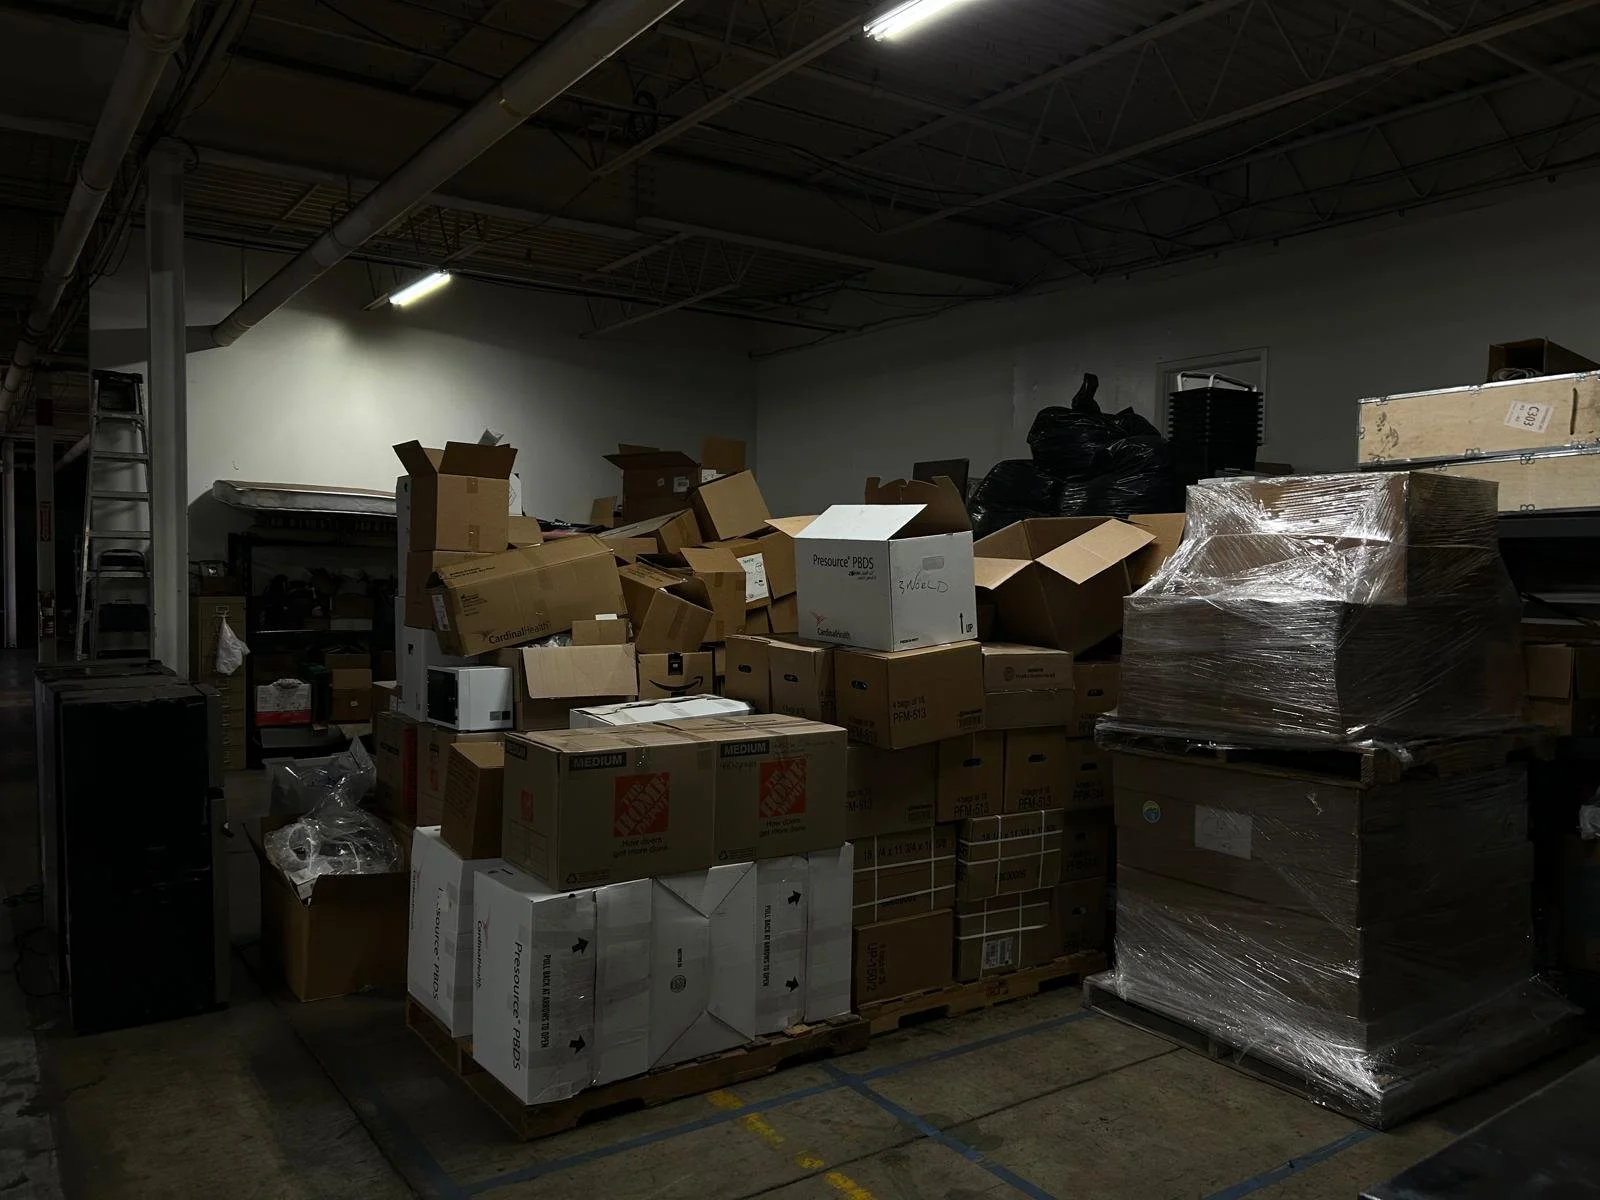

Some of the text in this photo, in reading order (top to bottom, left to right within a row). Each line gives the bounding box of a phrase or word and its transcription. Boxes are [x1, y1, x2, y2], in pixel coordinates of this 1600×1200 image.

[1523, 406, 1540, 427] C303
[852, 556, 874, 570] PBDS
[965, 623, 974, 634] UP
[723, 742, 767, 756] MEDIUM
[573, 753, 624, 769] MEDIUM
[475, 920, 483, 988] CardinalHealth
[543, 954, 551, 969] PULL
[432, 963, 440, 1001] PBDS
[542, 970, 551, 987] BACK
[541, 996, 550, 1022] ARROWS
[541, 1022, 550, 1031] TO
[541, 1031, 550, 1048] OPEN
[513, 1027, 521, 1071] PBDS
